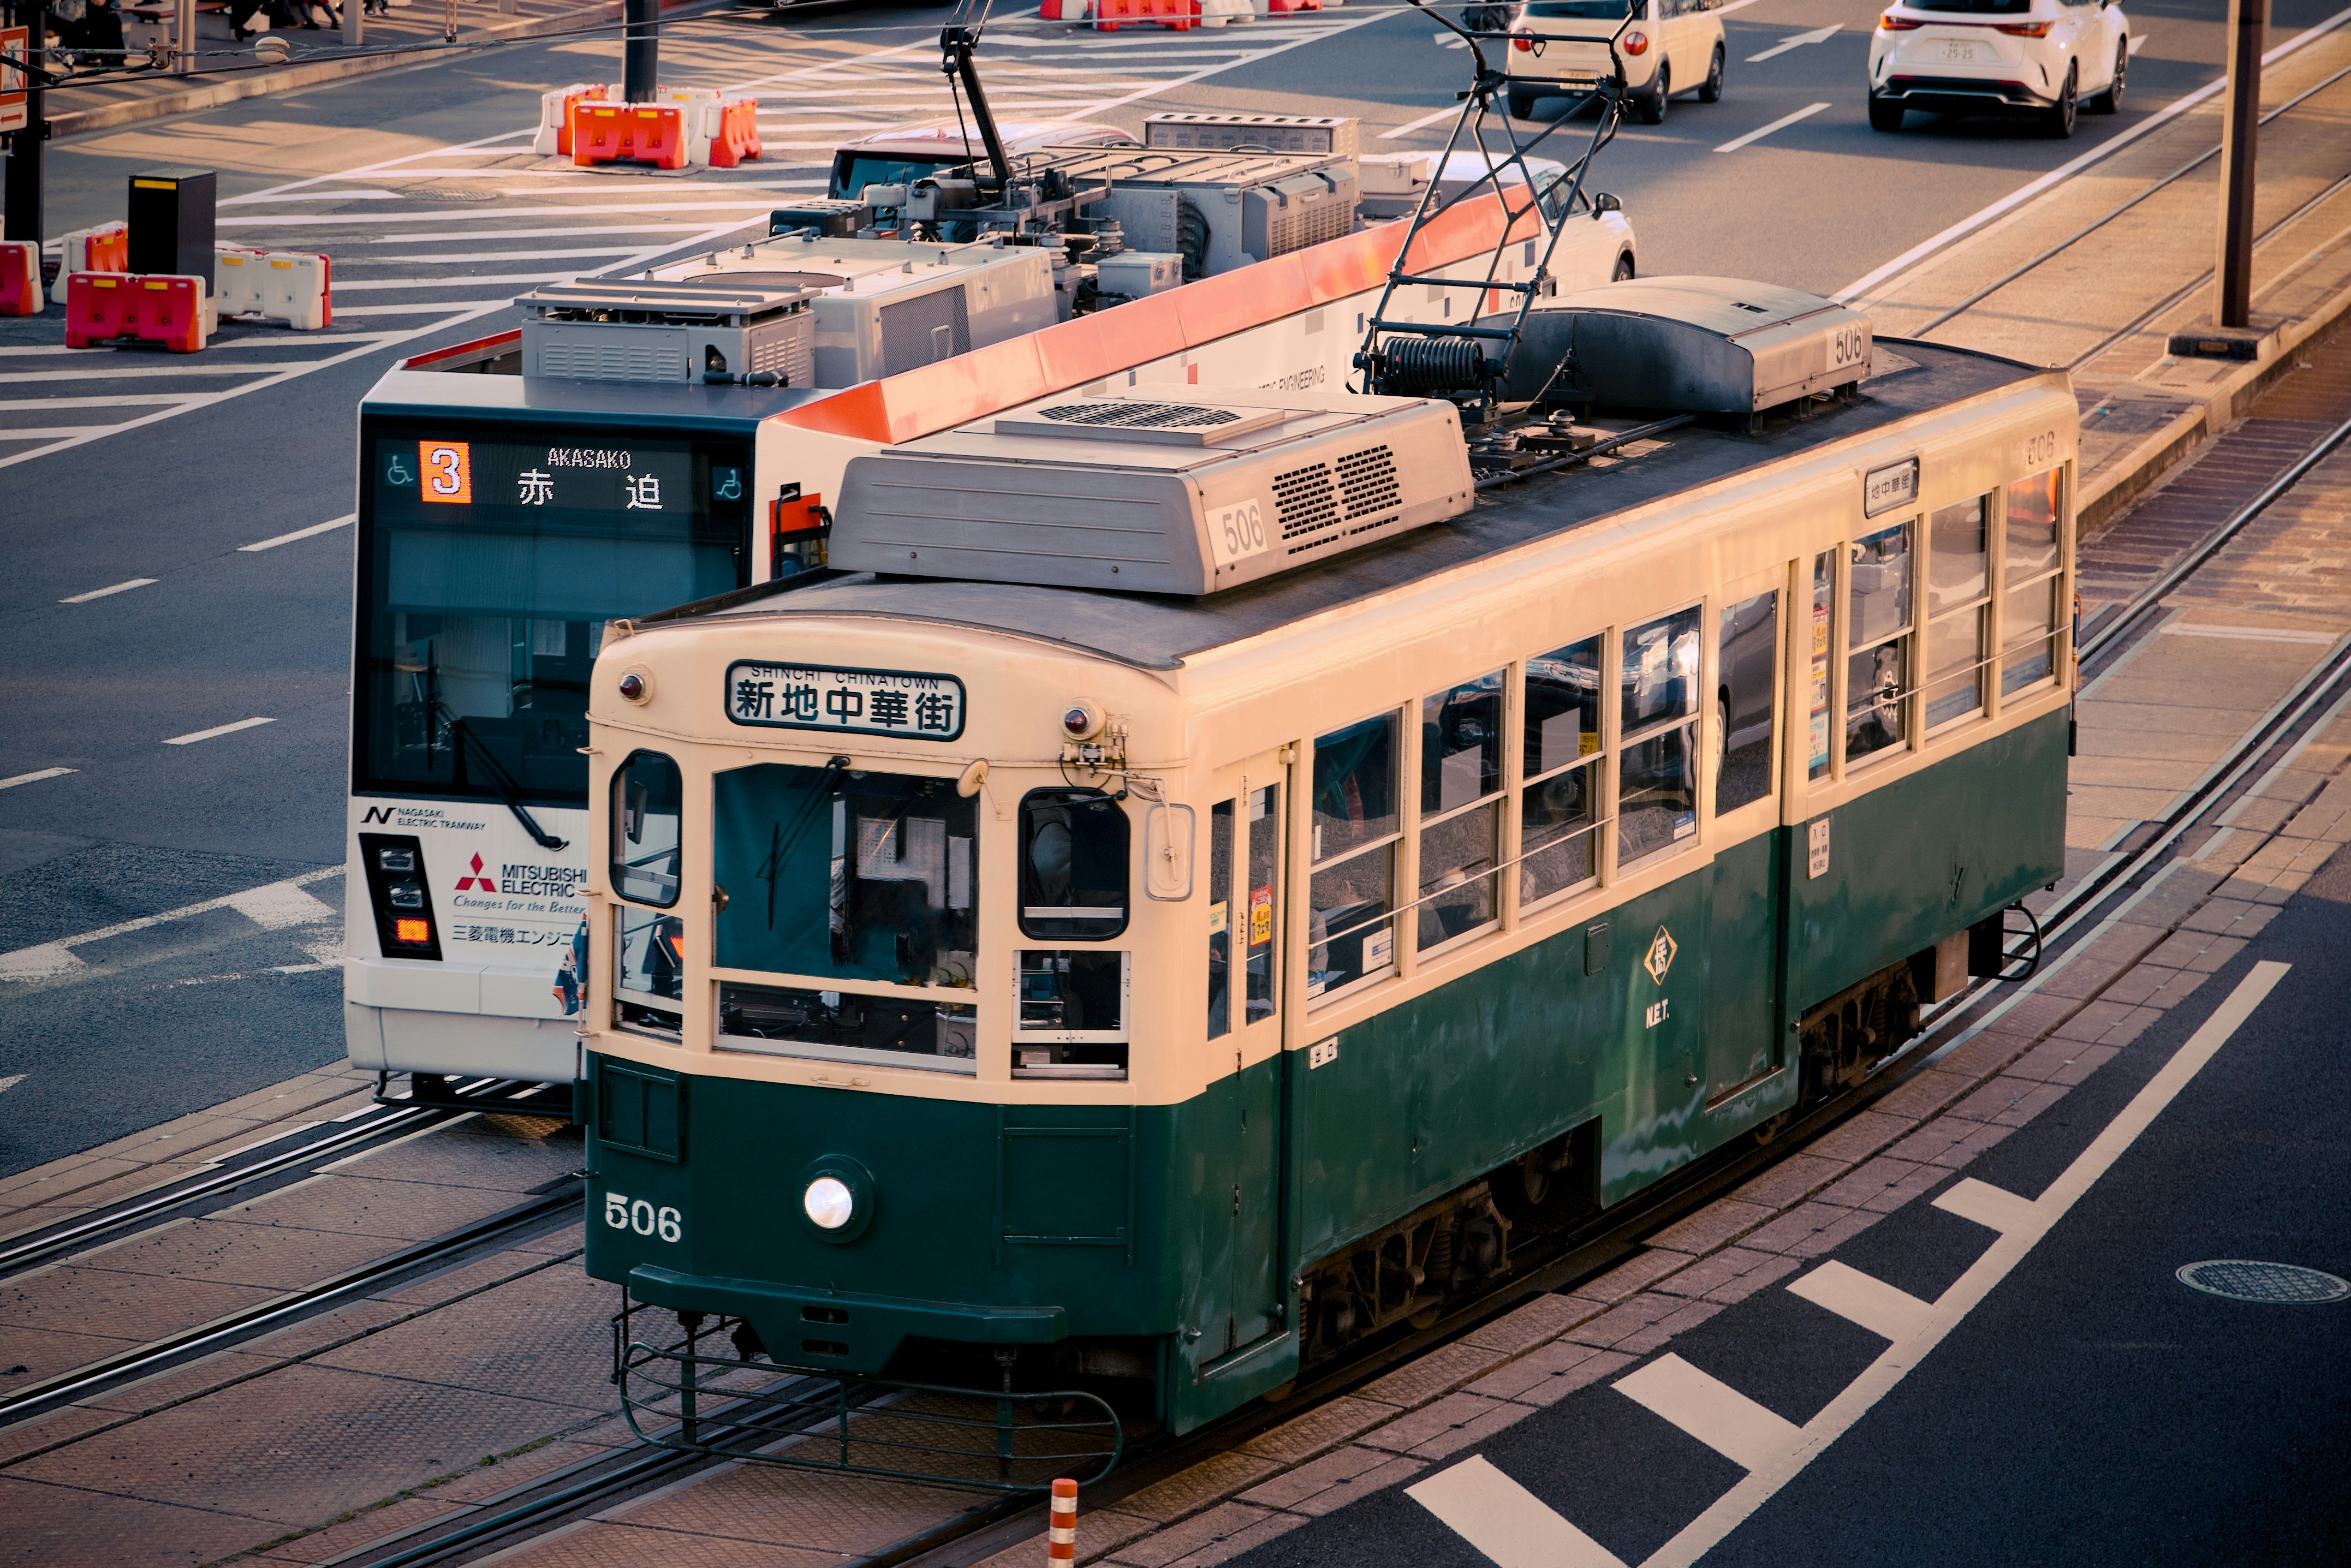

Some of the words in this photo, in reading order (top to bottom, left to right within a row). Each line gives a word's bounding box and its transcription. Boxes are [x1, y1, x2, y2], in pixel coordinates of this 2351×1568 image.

[1836, 326, 1862, 364] 506
[1279, 365, 1324, 390] ENGINEERING
[547, 448, 632, 469] AKASAKO
[2028, 430, 2055, 465] 506
[431, 449, 460, 495] 3
[517, 468, 663, 510] 赤迫
[1867, 473, 1909, 502] 地中華街
[1223, 504, 1264, 555] 506
[751, 667, 820, 682] SHINCHI
[836, 672, 939, 690] CHINATOWN
[736, 679, 954, 732] 新地中華街
[398, 808, 444, 818] NAGASAKI
[398, 818, 438, 828] ELECTRIC
[440, 820, 486, 831] TRAMWAY
[502, 864, 587, 883] MITSUBISHI
[501, 880, 576, 898] ELECTRIC
[453, 895, 502, 910] Changes
[505, 900, 526, 911] for
[527, 902, 545, 912] the
[549, 901, 586, 914] Better
[452, 925, 575, 947] 三菱電機エンジニ
[1316, 1043, 1333, 1063] 出口
[605, 1191, 682, 1243] 506
